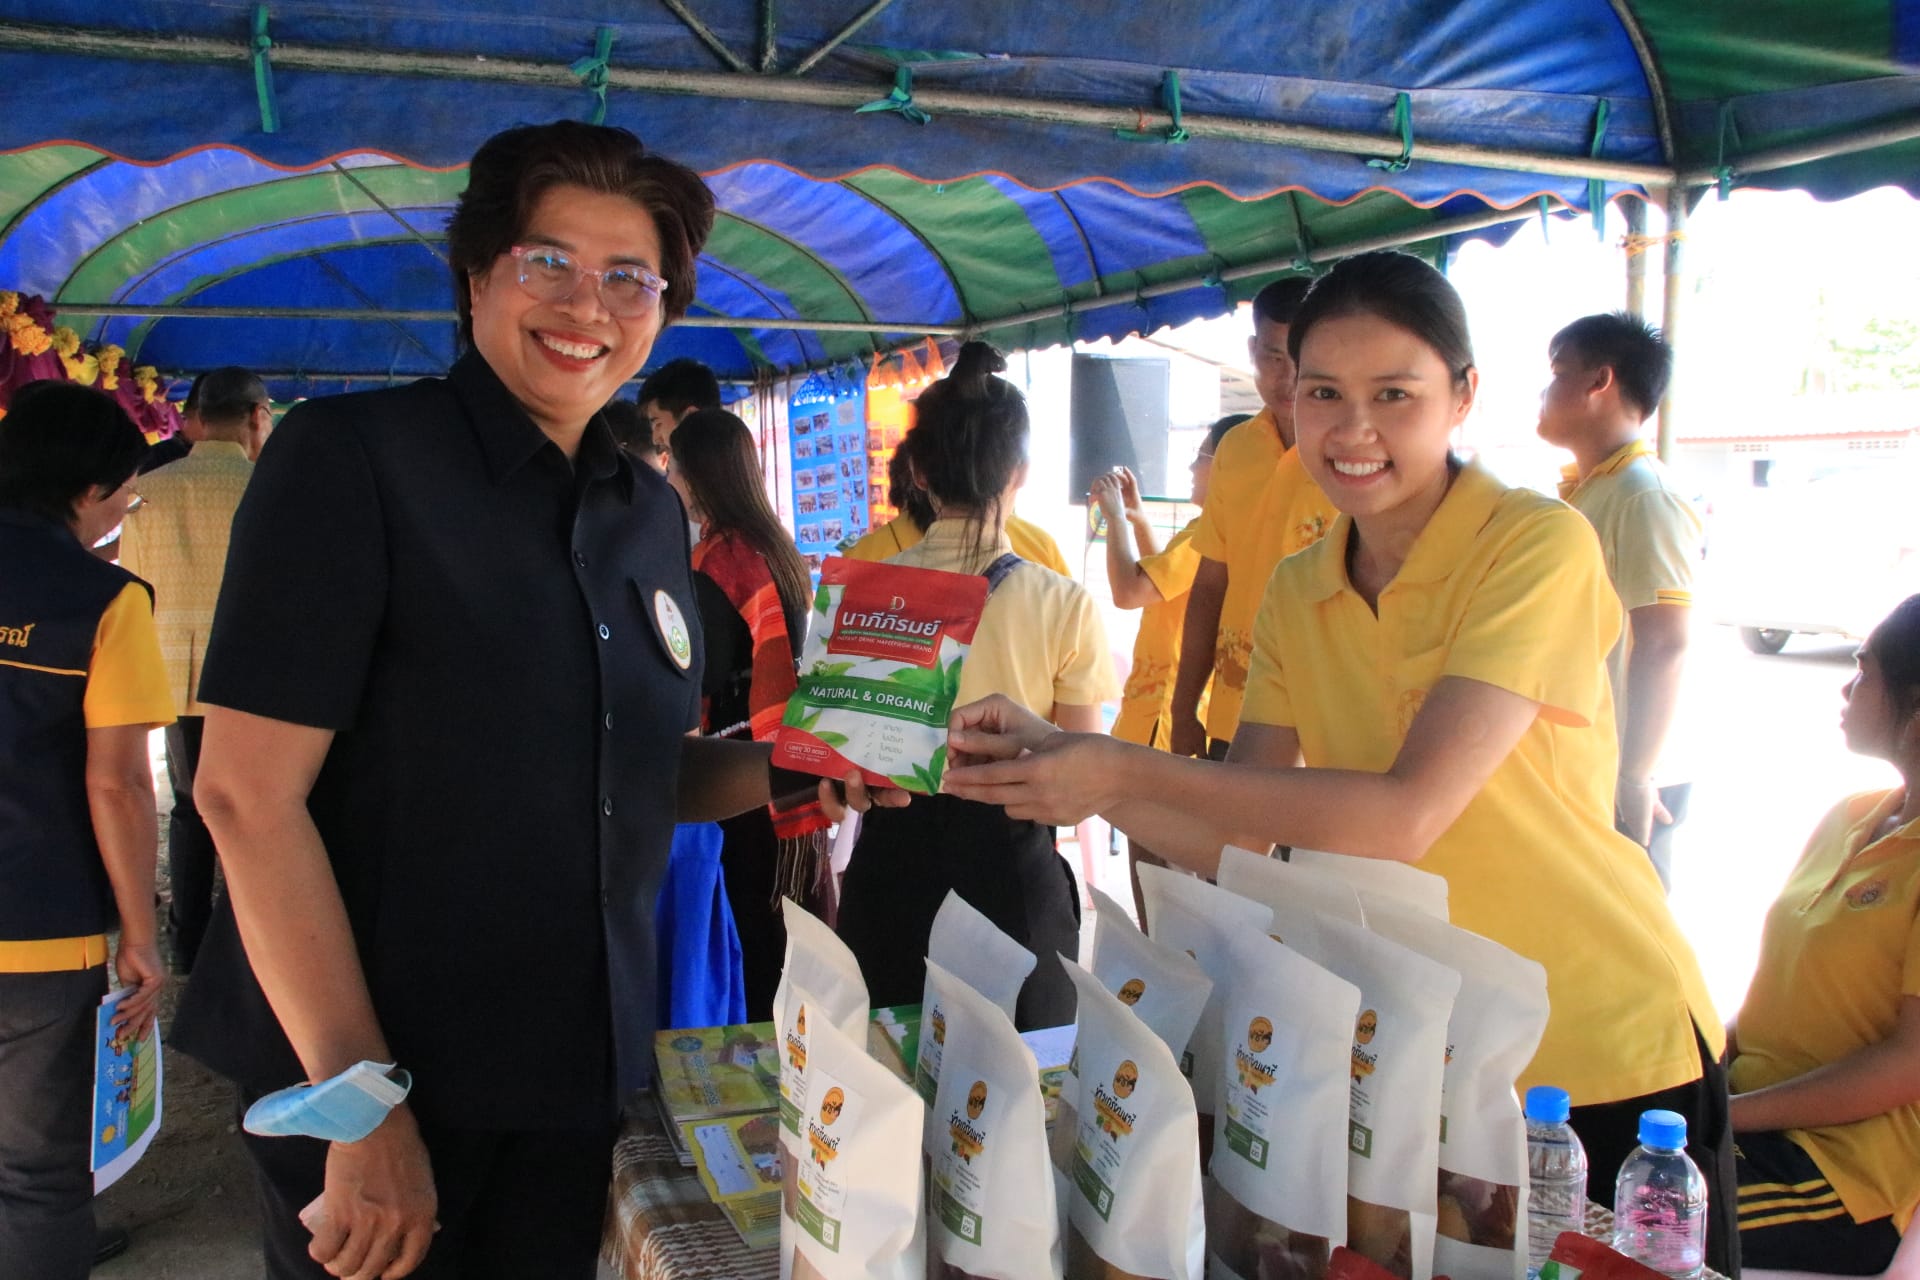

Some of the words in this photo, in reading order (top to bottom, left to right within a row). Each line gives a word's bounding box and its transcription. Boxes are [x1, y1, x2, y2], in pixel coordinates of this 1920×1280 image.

[842, 612, 942, 636] นาภีภิรมย์
[808, 685, 859, 700] NATURAL
[862, 690, 872, 702] &
[875, 693, 935, 716] ORGANIC
